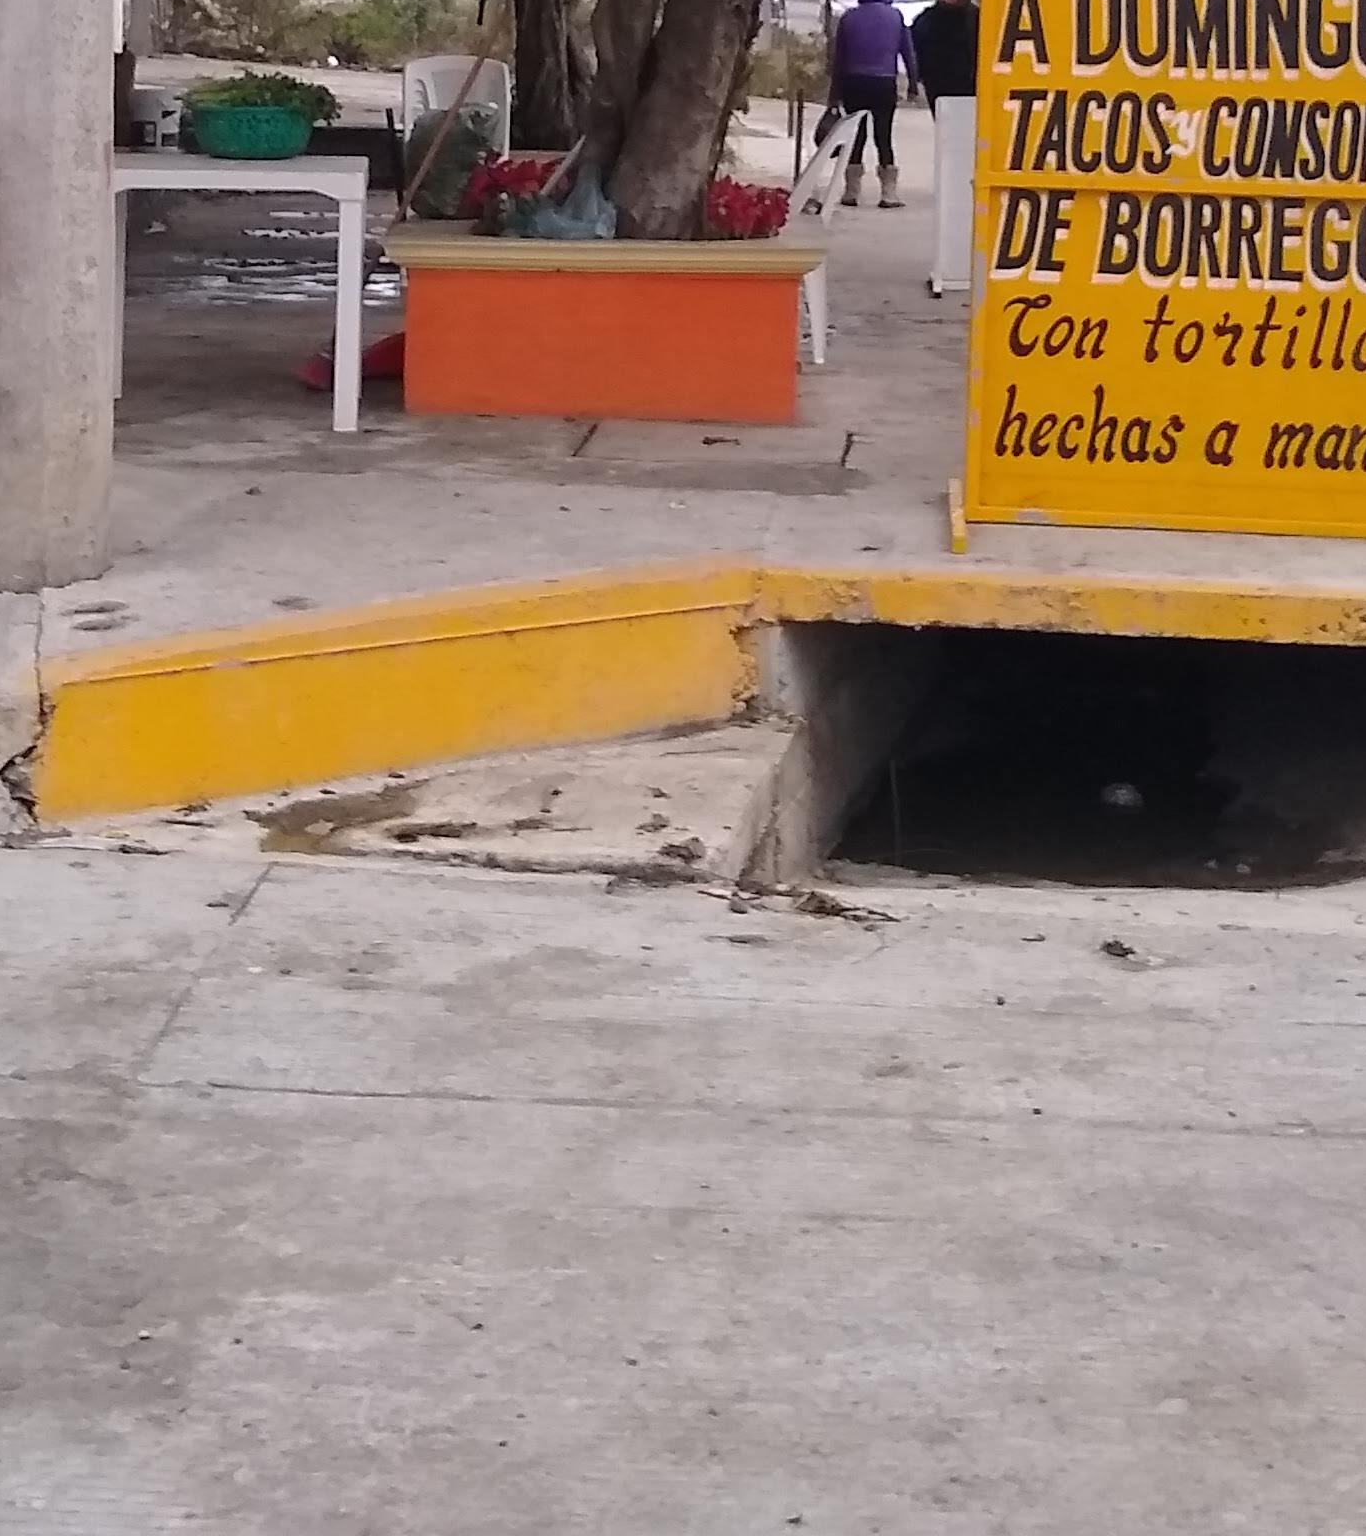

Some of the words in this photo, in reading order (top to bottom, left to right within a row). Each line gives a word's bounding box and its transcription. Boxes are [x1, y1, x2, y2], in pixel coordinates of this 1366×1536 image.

[1004, 89, 1178, 174] TACOS
[990, 188, 1075, 282] DE
[1003, 294, 1109, 359] Con
[994, 384, 1185, 465] hechas
[1204, 420, 1241, 467] a
